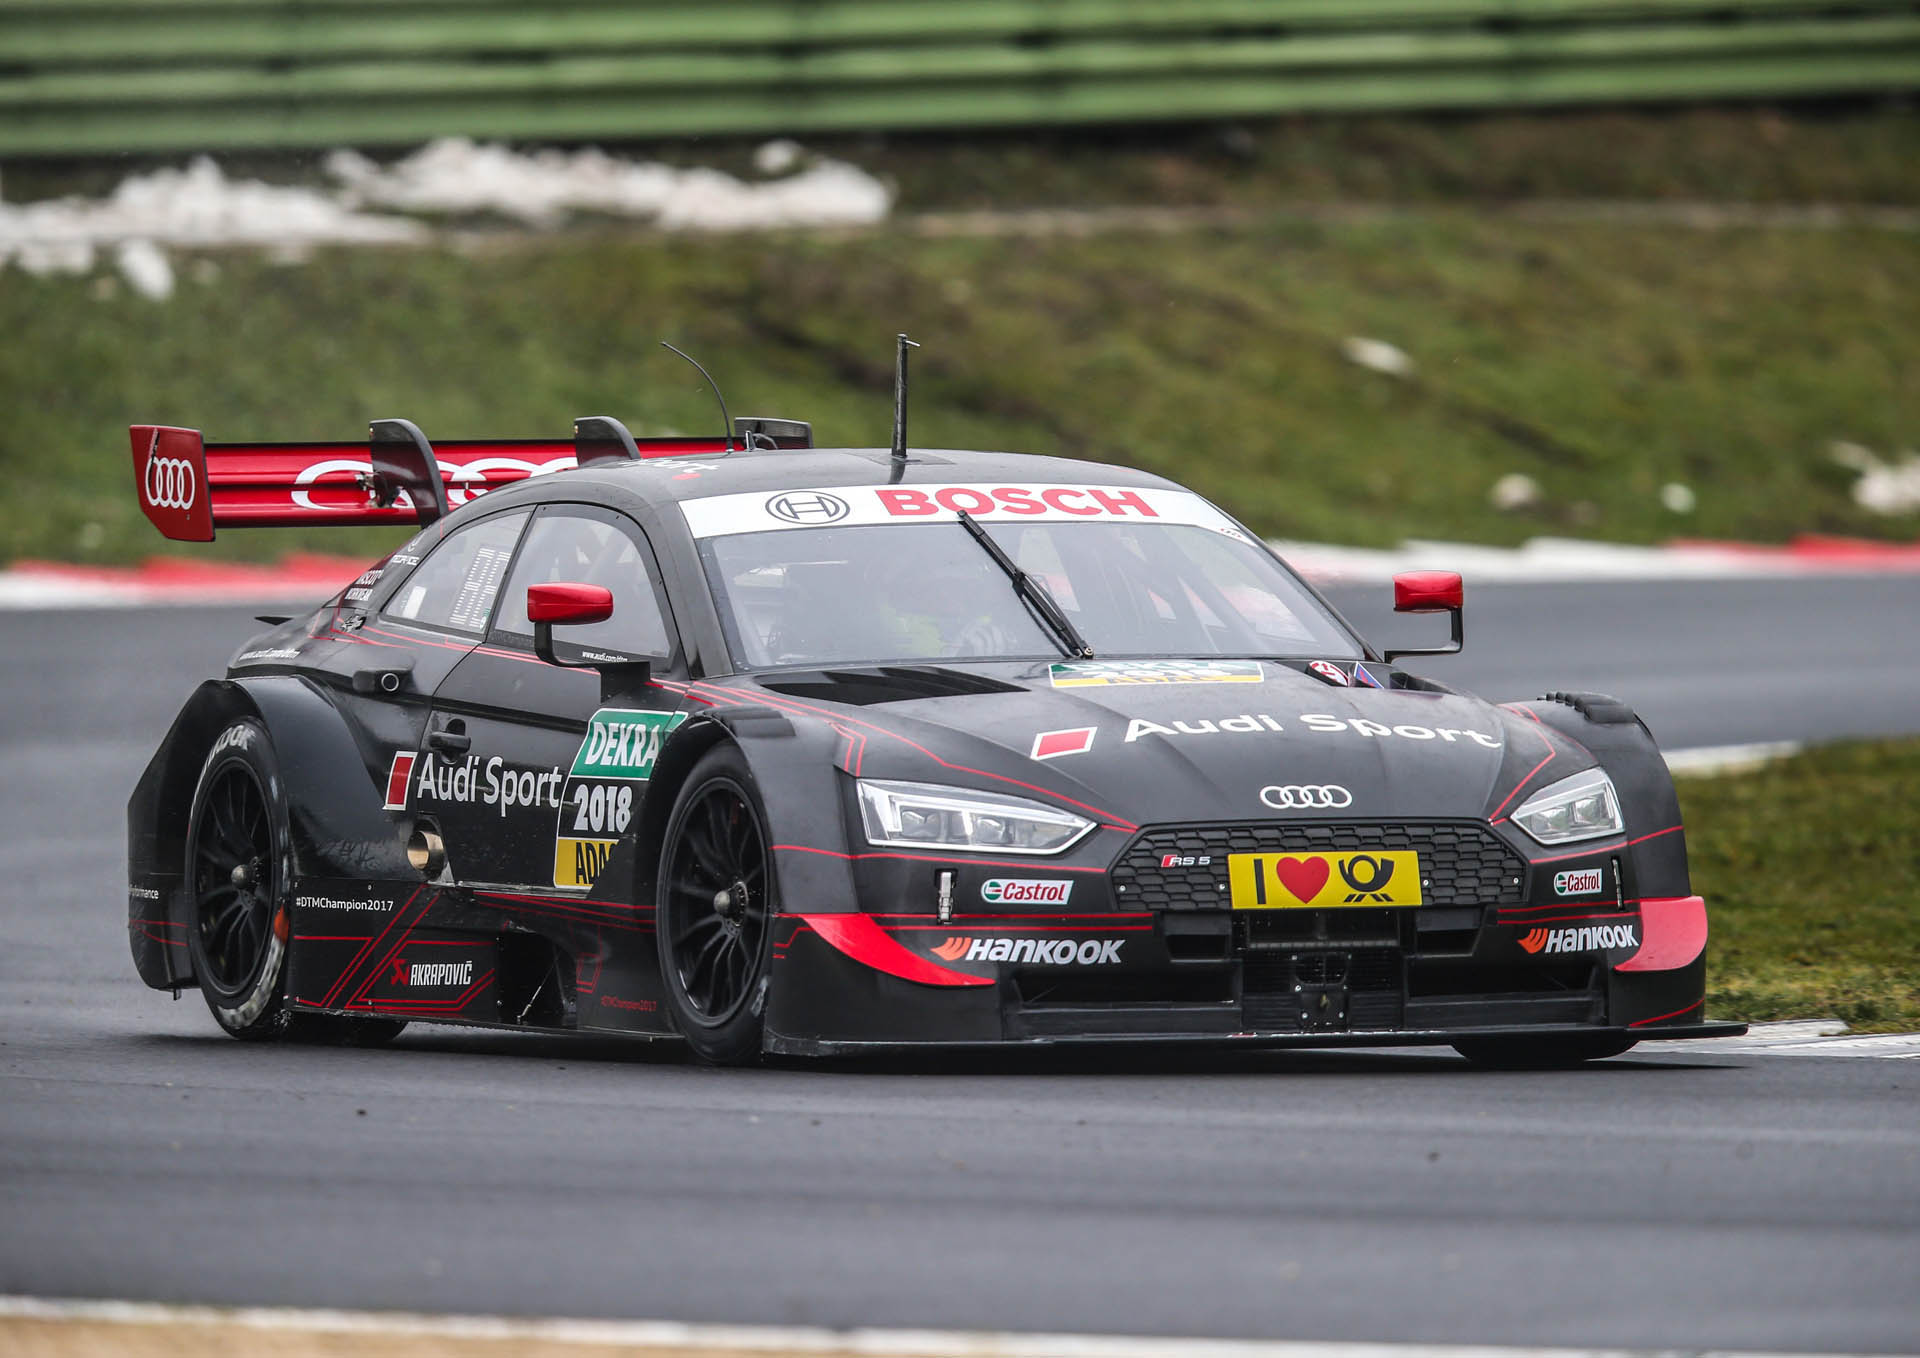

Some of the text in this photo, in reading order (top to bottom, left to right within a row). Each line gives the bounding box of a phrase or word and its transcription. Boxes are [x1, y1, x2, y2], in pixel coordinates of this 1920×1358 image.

[875, 487, 1160, 517] BOSCH
[584, 721, 660, 767] DEKRA
[1124, 714, 1502, 748] Audi Sport
[417, 752, 562, 817] Audi Sport
[573, 784, 632, 833] 2018
[575, 842, 617, 884] ADA
[1169, 856, 1211, 867] RS 5
[1003, 882, 1066, 901] Castrol
[1253, 858, 1267, 905] I
[1567, 872, 1600, 892] Castrol
[296, 897, 394, 912] #DTMChampion2017
